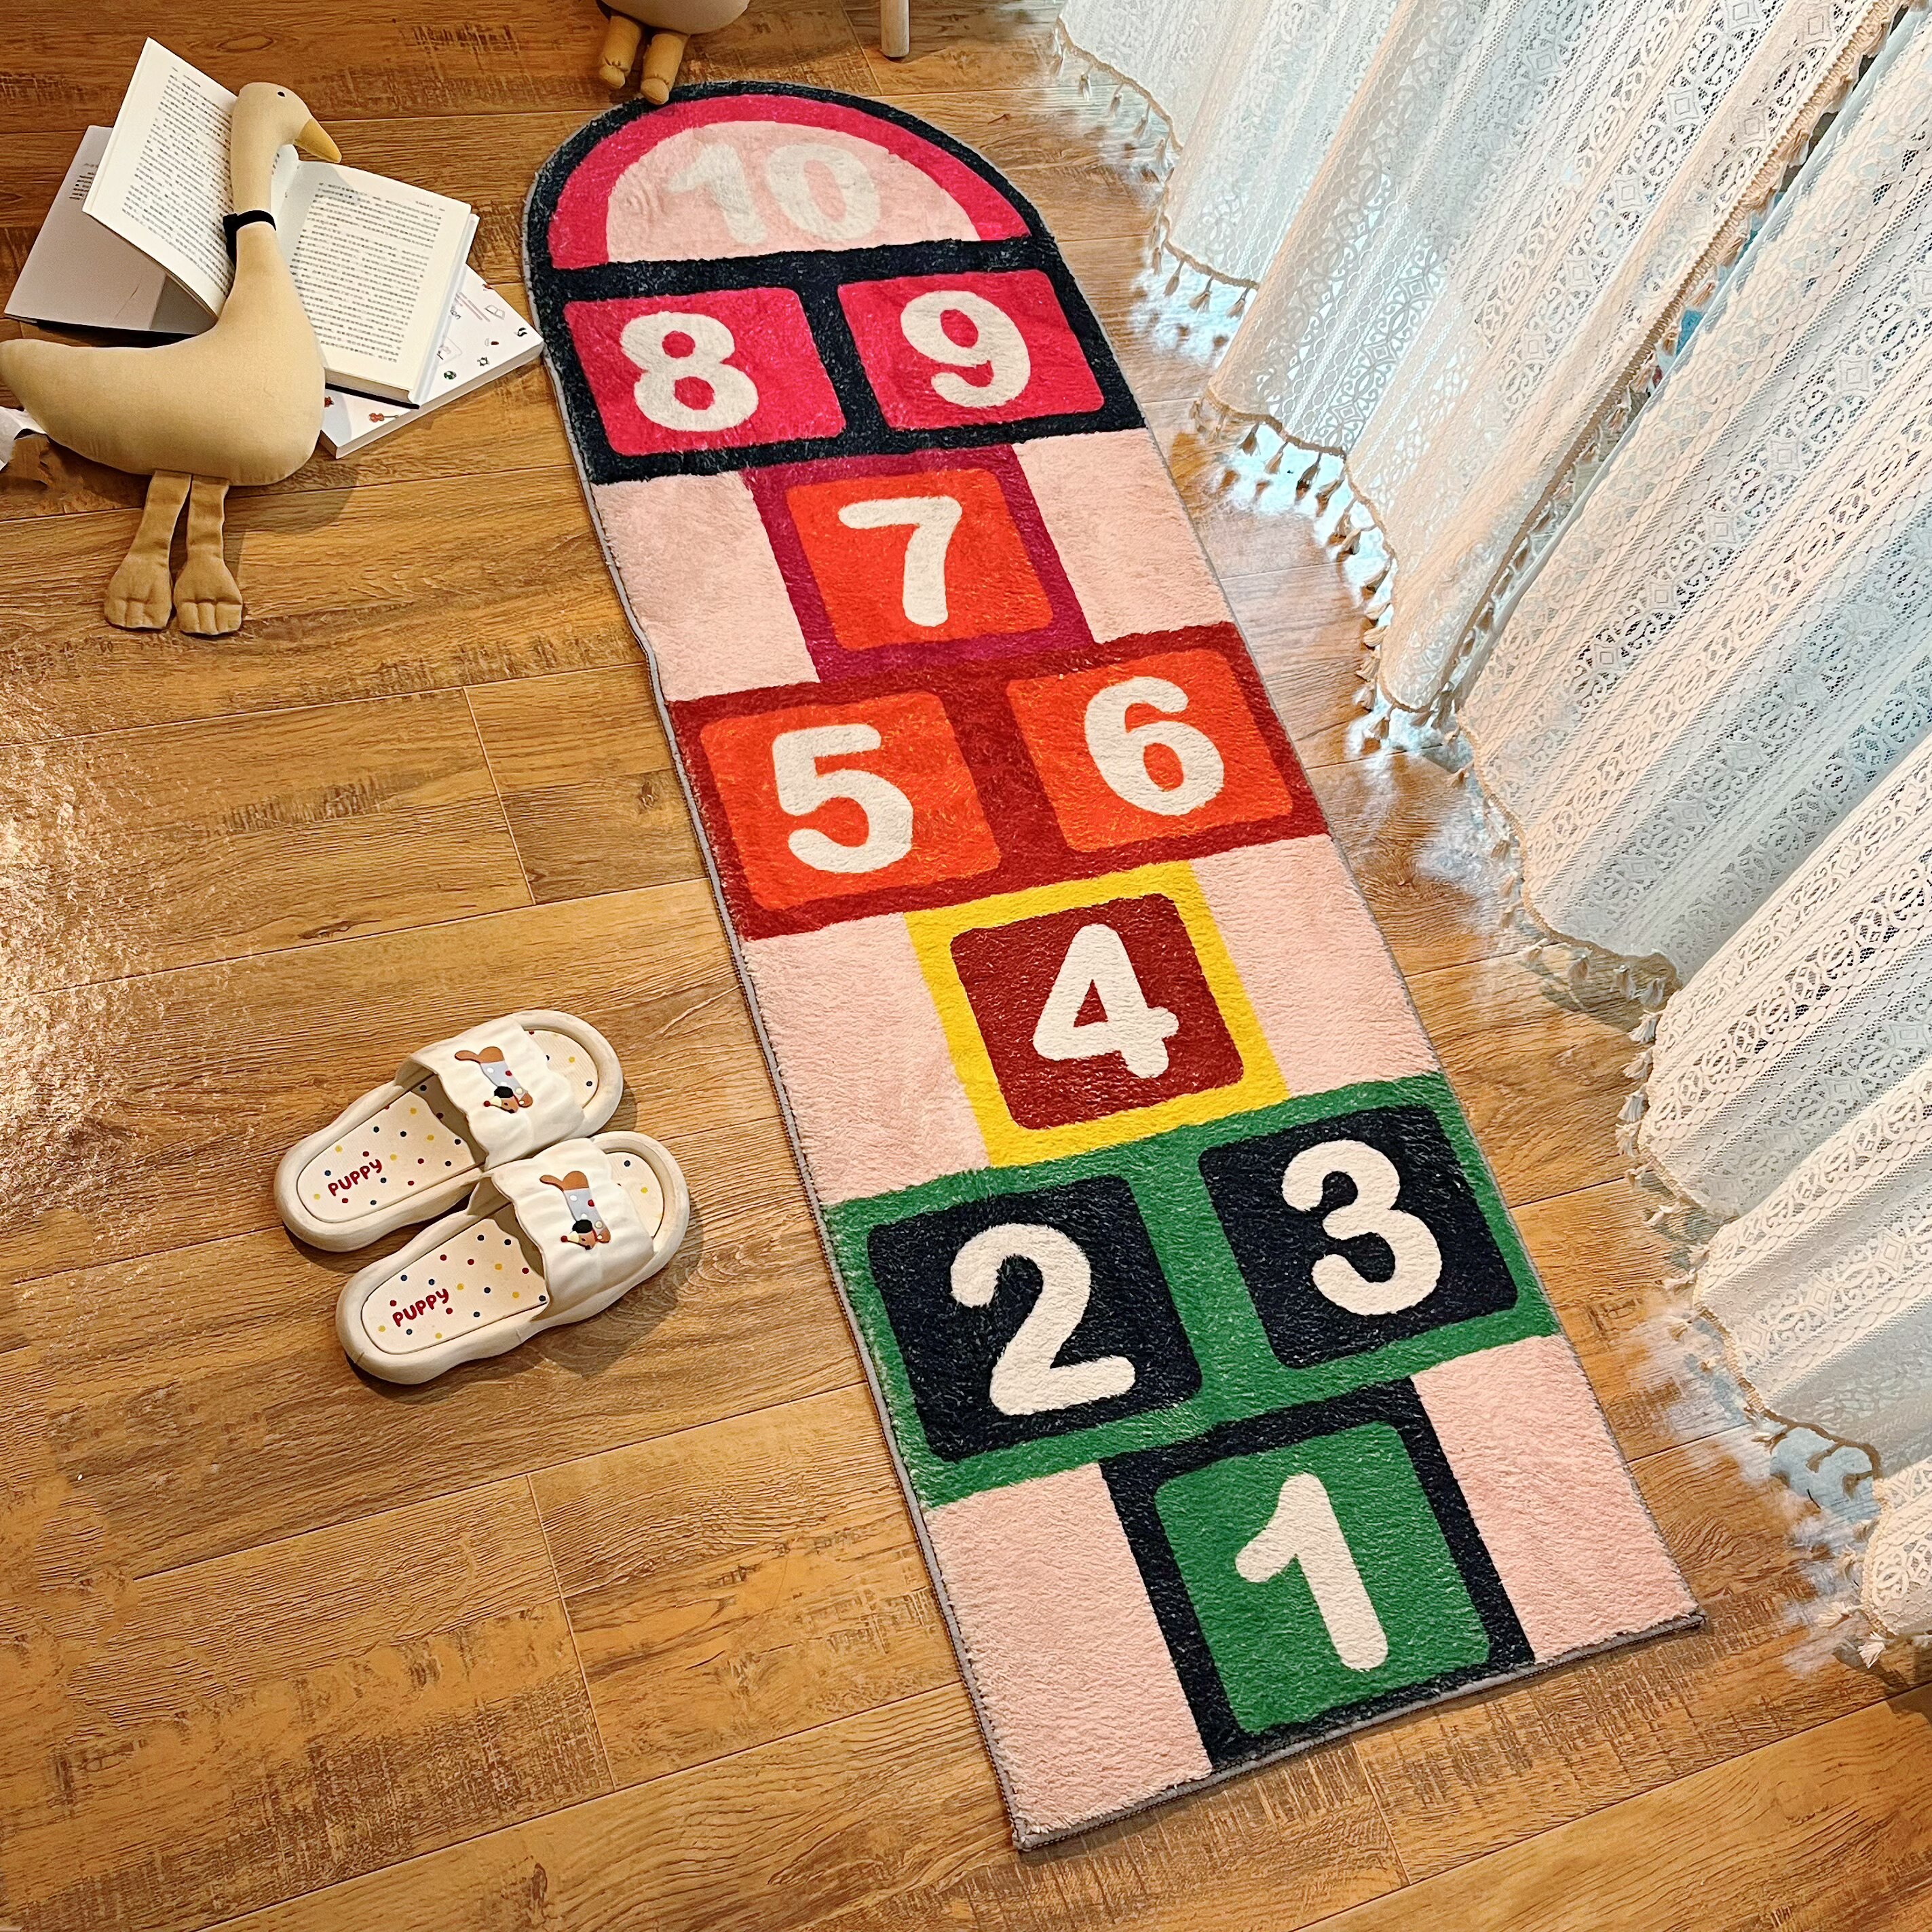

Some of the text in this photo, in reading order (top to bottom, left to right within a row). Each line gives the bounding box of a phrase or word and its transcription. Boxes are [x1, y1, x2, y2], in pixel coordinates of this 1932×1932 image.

[664, 140, 882, 247] 10
[621, 311, 759, 433] 8
[900, 290, 1031, 407] 9
[840, 497, 962, 626] 7
[772, 725, 913, 874] 5
[1086, 678, 1225, 816] 6
[1033, 924, 1180, 1079] 4
[1281, 1139, 1443, 1317] 3
[951, 1223, 1136, 1416] 2
[1234, 1473, 1388, 1671] 1
